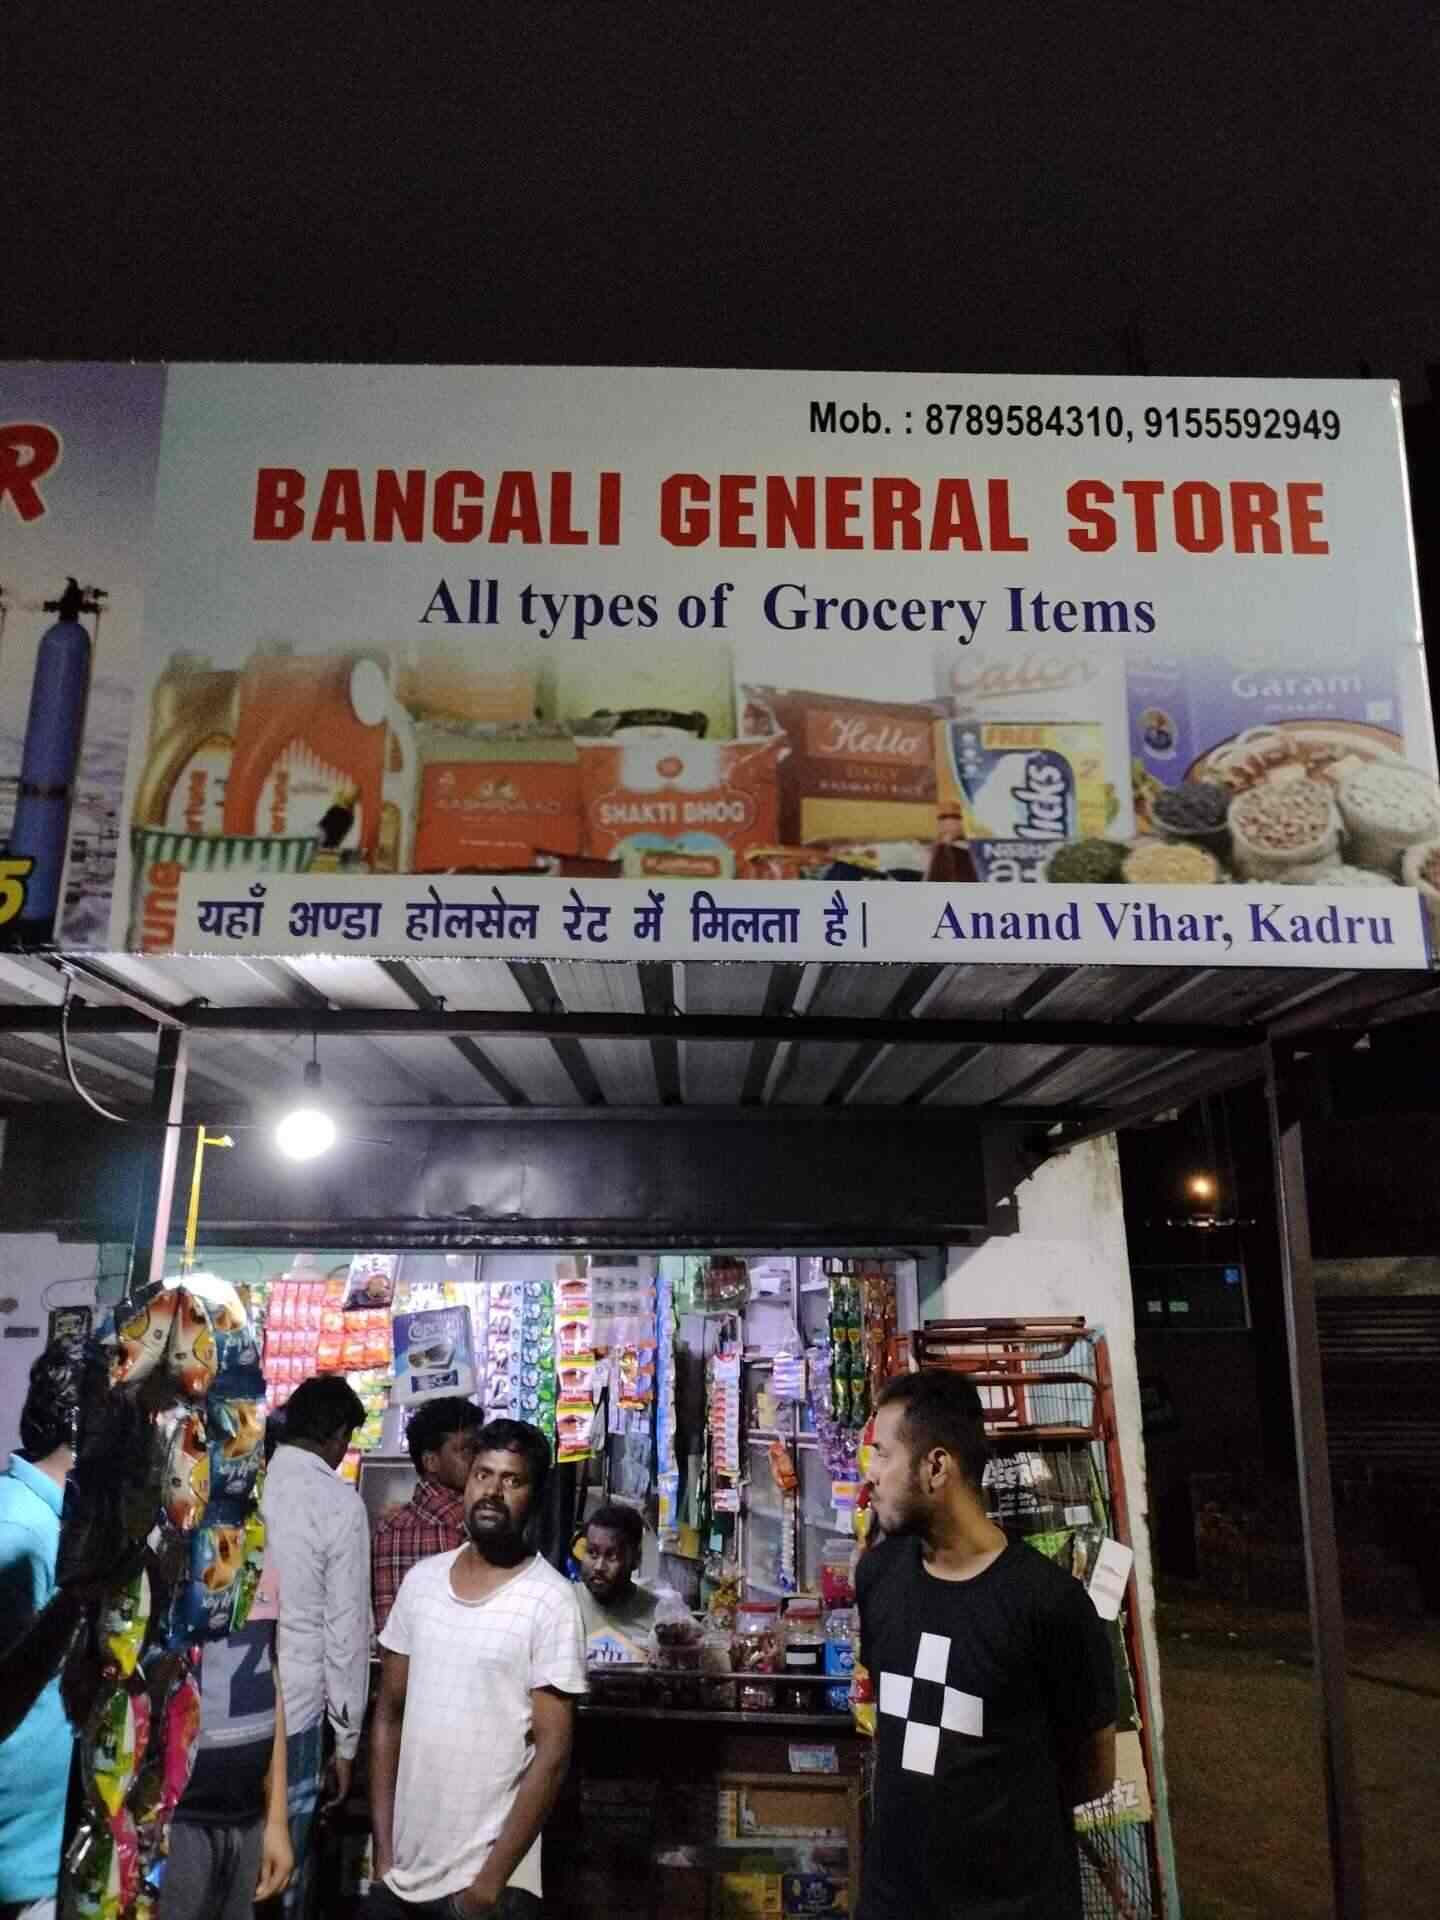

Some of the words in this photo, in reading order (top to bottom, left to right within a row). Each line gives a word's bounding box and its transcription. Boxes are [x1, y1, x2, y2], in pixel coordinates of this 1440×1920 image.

[809, 401, 892, 435] Mob.
[925, 404, 1134, 443] 8789584310,
[1143, 407, 1341, 441] 9155592949
[254, 469, 620, 546] BANGALI
[660, 475, 1027, 552] GENERAL
[1065, 479, 1329, 555] STORE
[418, 577, 499, 625] All
[520, 583, 659, 641] types
[678, 582, 735, 628] of
[763, 583, 986, 645] Grocery
[1006, 587, 1156, 634] Items
[1232, 673, 1361, 699] Garam
[600, 800, 677, 824] SHAKTI
[197, 882, 268, 940] यहाँ
[288, 901, 383, 941] अण्डा
[405, 884, 540, 942] होलसेल
[562, 886, 612, 943] रेट
[633, 888, 666, 943] में
[689, 890, 801, 944] मिलता
[932, 901, 1081, 941] Anand
[1095, 902, 1233, 945] Vihar,
[1249, 903, 1393, 945] Kadru
